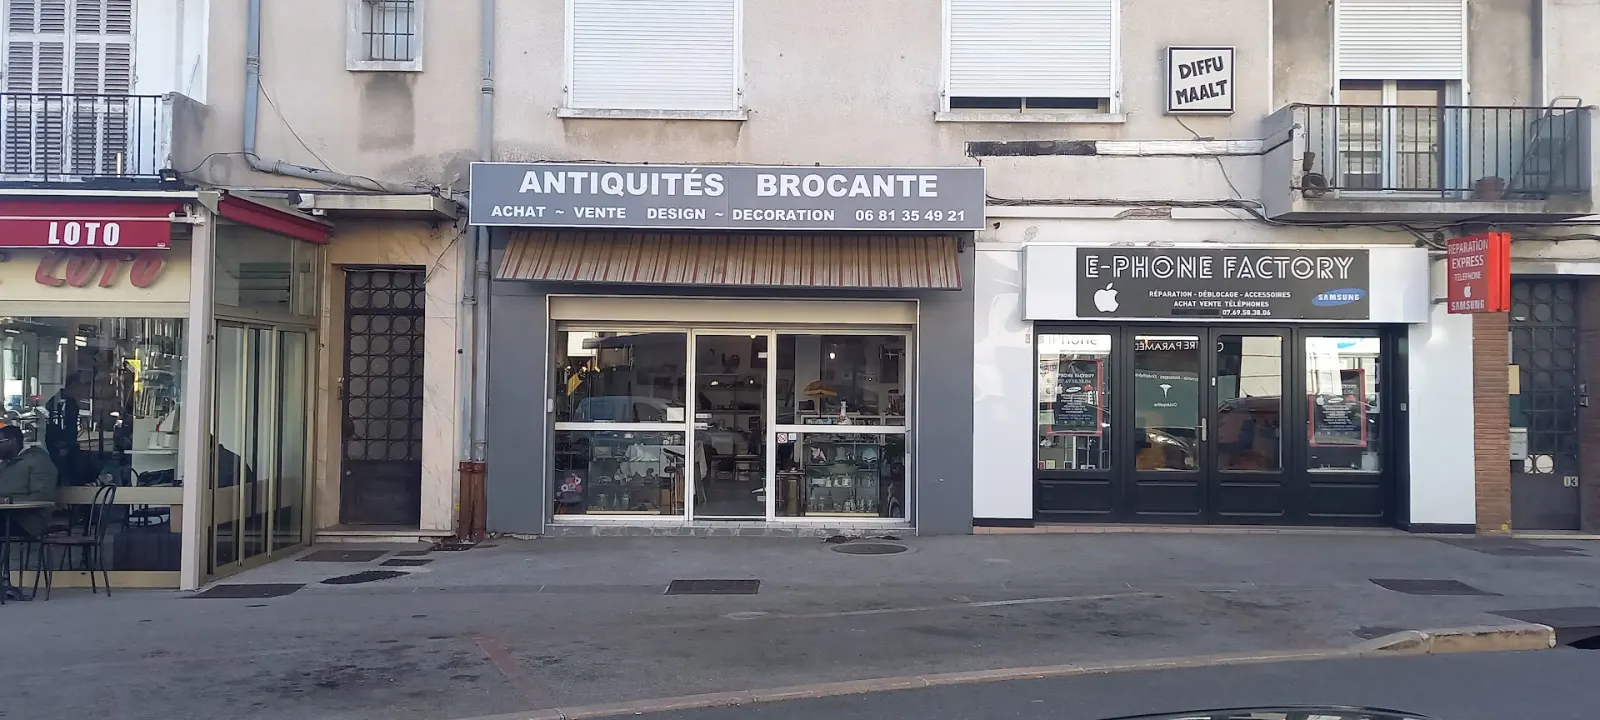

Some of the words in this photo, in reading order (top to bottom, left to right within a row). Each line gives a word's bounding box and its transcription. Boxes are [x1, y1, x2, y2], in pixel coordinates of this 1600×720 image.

[1178, 56, 1224, 79] DIFFU
[1175, 79, 1227, 105] MAALT
[518, 168, 725, 197] ANTIQUITÉS
[756, 174, 938, 198] BROCANTE
[491, 205, 546, 218] ACHAT
[573, 207, 626, 219] VENTE
[647, 208, 706, 220] DESIGN
[732, 209, 835, 221] DECORATION
[855, 210, 874, 221] 06
[878, 210, 896, 221] 81
[901, 210, 920, 221] 35
[924, 210, 943, 221] 49
[947, 210, 965, 221] 21
[48, 222, 120, 246] LOTO
[1085, 255, 1213, 279] E-PHONE
[1223, 256, 1354, 280] FACTORY
[1452, 255, 1484, 268] EXPRESS
[1149, 289, 1193, 298] RÉPARATION
[1198, 290, 1239, 298] DÉBLOCAGE
[1318, 293, 1360, 301] SAMSUNG
[1224, 300, 1270, 308] TÉLÉPHONES
[1451, 300, 1485, 310] SAMSUNG
